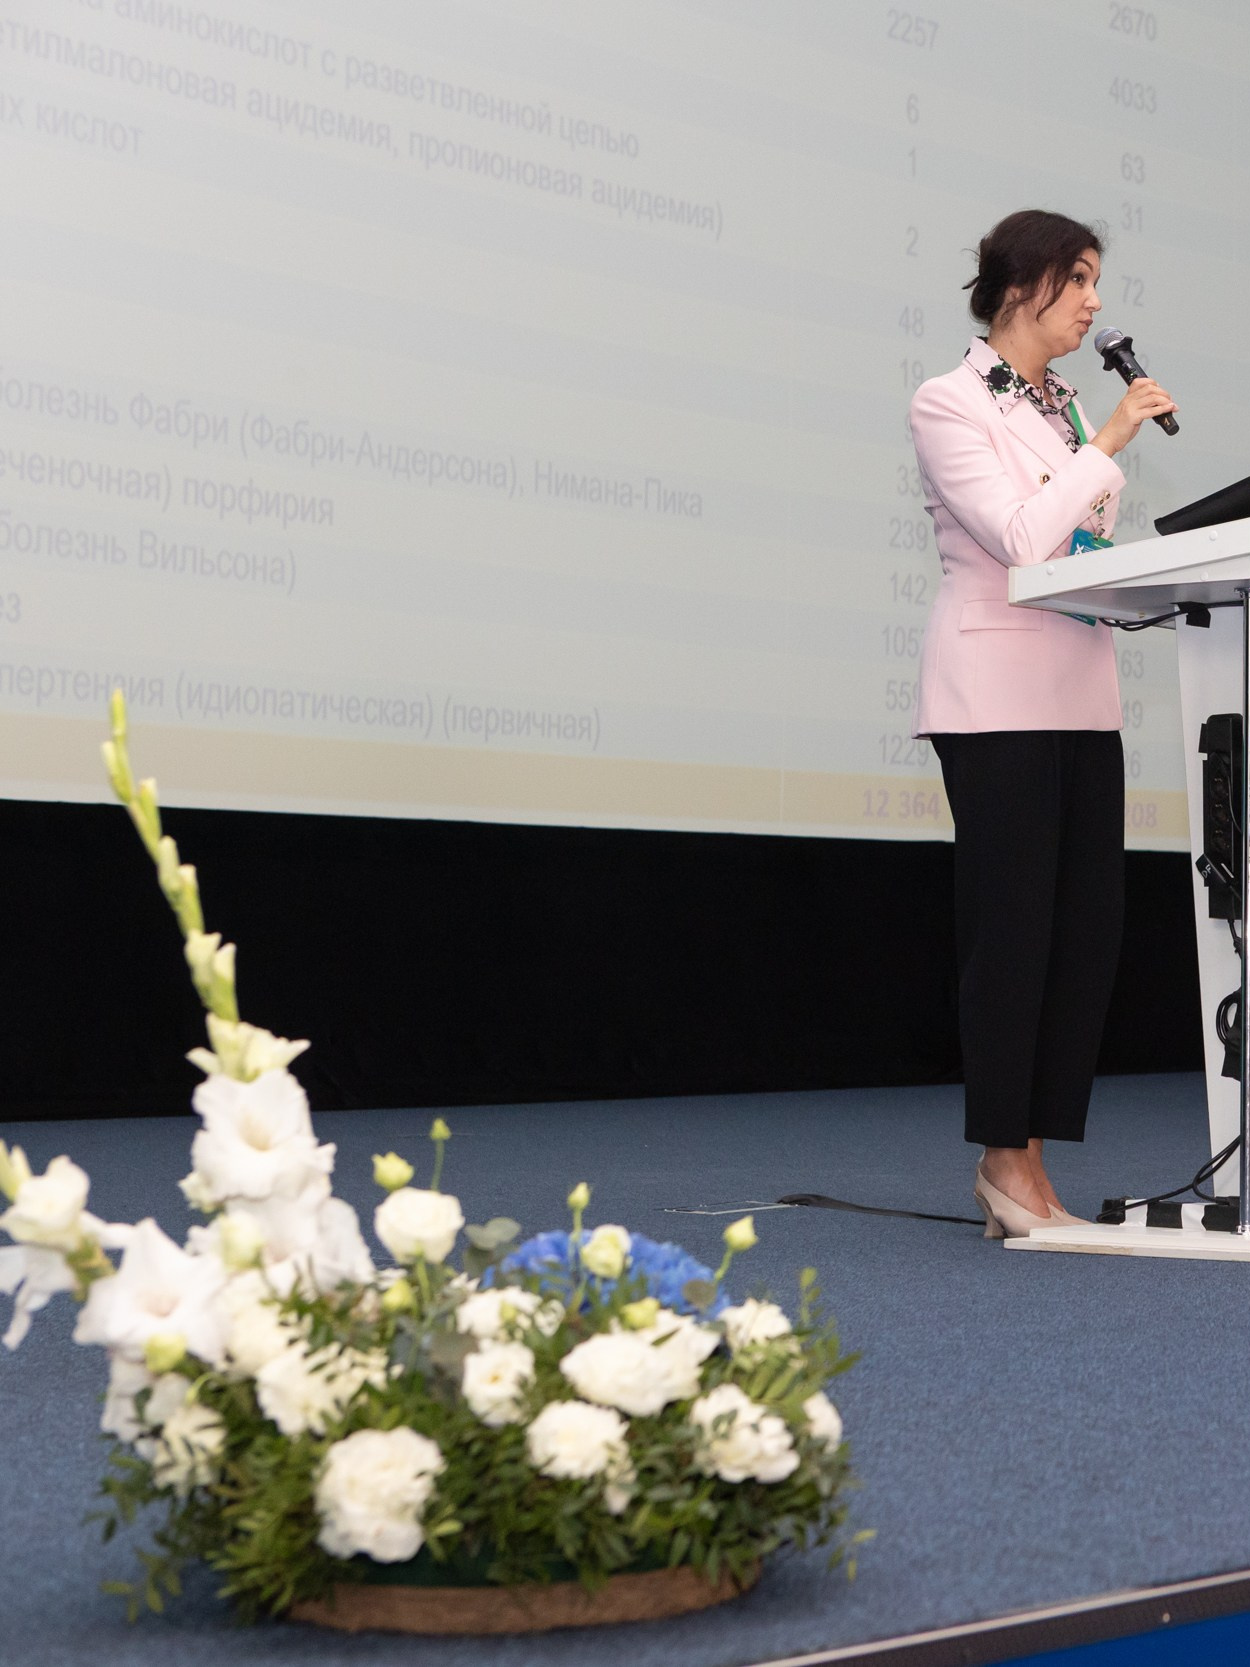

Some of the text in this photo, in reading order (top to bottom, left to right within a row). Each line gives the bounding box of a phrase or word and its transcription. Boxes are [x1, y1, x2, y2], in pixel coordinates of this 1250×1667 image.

[887, 9, 939, 50] 2257
[1109, 4, 1158, 41] 2670
[321, 48, 338, 77] с
[345, 55, 552, 137] разветвленной
[559, 115, 640, 160] цепью
[906, 93, 920, 124] 6
[1109, 77, 1158, 115] 4033
[0, 18, 237, 110] тилмалоновая
[408, 130, 584, 199] пропионовая
[591, 177, 724, 242] ацидемия)
[36, 102, 145, 155] кислот
[907, 148, 918, 177] 1
[1121, 153, 1146, 185] 63
[1121, 202, 1144, 233] 31
[906, 226, 920, 257] 2
[1121, 275, 1145, 308] 72
[900, 306, 925, 338] 48
[0, 366, 119, 427] олезнь
[129, 392, 230, 449] Фабри
[533, 459, 704, 519] Нимана-Пика
[182, 477, 336, 530] порфирия
[889, 518, 929, 552] 239
[138, 528, 297, 597] Вильсона)
[889, 571, 928, 605] 142
[881, 624, 925, 660] 105
[1114, 648, 1144, 680] 63
[175, 669, 434, 741] (идиопатическая)
[443, 693, 602, 752] (первичная)
[878, 734, 930, 768] 1229
[1125, 802, 1158, 829] 08
